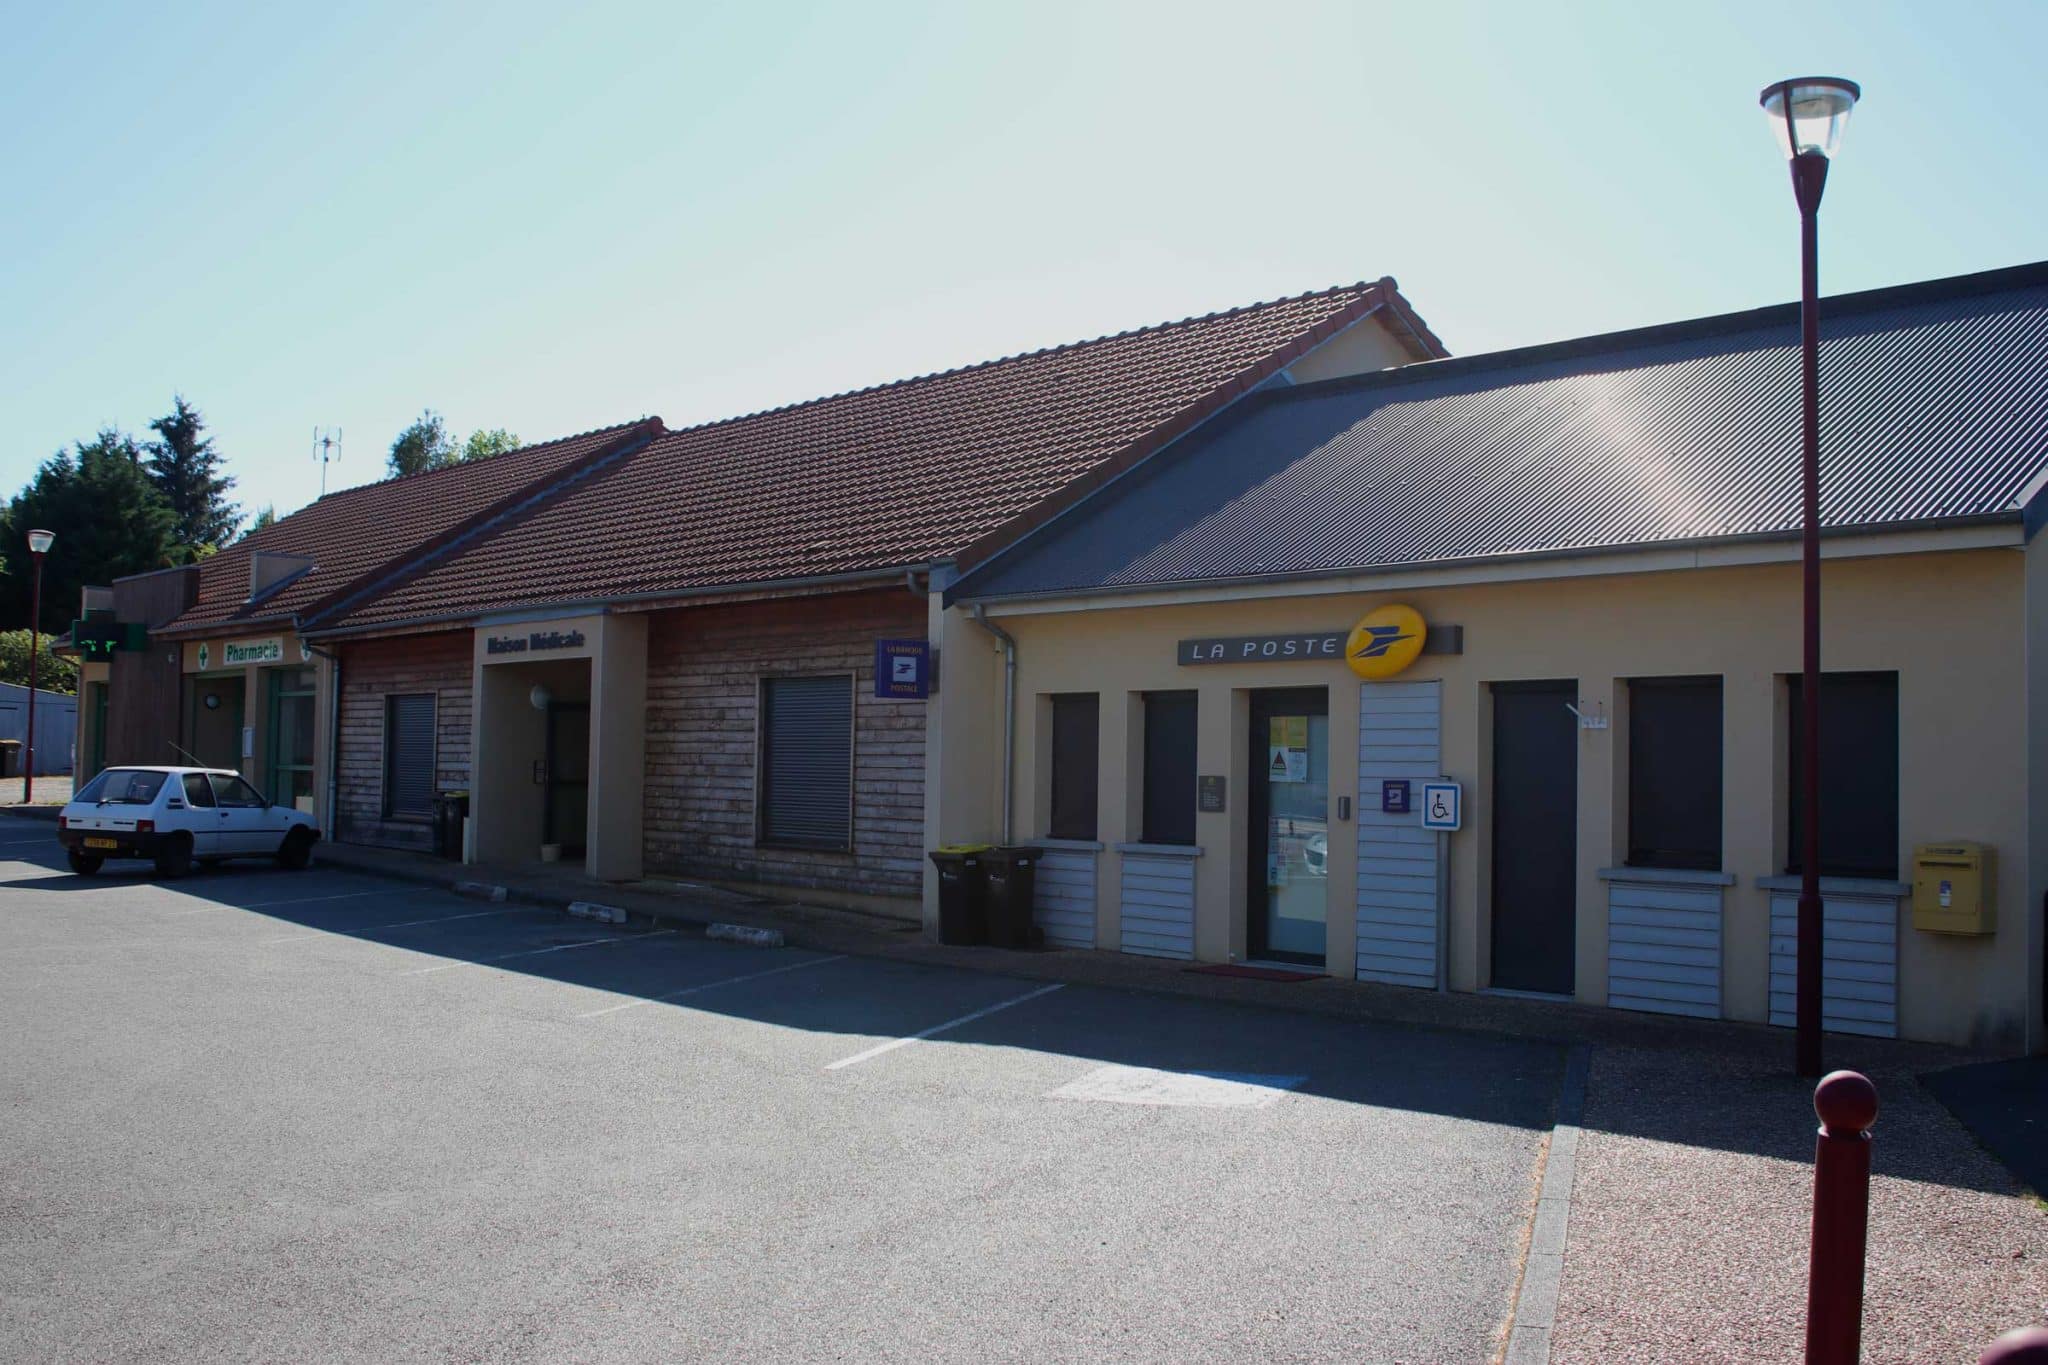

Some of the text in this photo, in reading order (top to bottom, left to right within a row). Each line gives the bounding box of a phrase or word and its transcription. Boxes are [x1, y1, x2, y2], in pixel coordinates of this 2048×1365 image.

[226, 640, 278, 662] Pharmacie
[487, 629, 585, 654] Maison Médicale
[1192, 638, 1337, 659] LA POSTE
